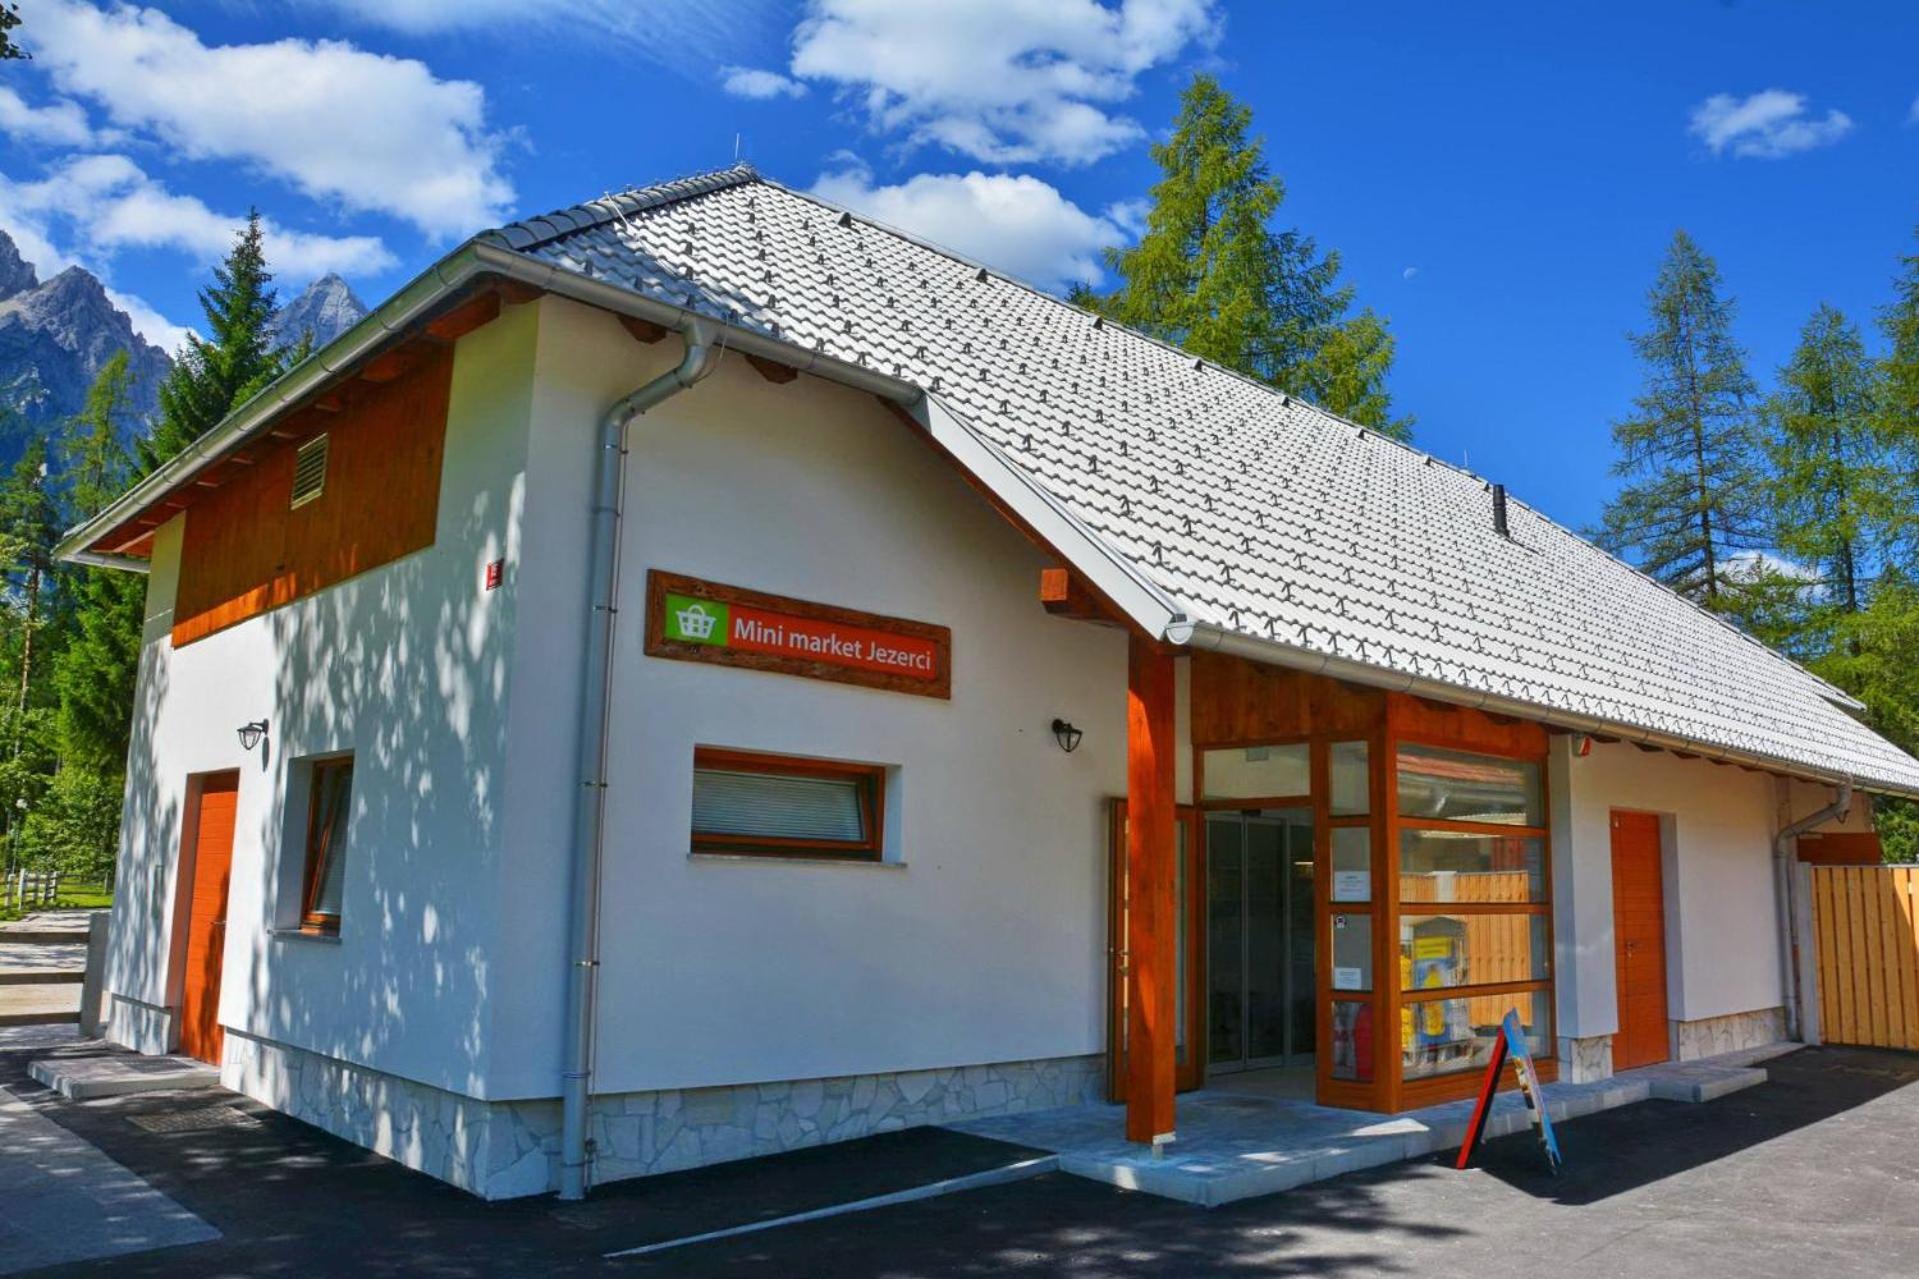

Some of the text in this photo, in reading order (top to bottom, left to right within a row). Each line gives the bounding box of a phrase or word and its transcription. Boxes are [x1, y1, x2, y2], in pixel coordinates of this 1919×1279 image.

[734, 618, 930, 670] Mini market Jezerci
